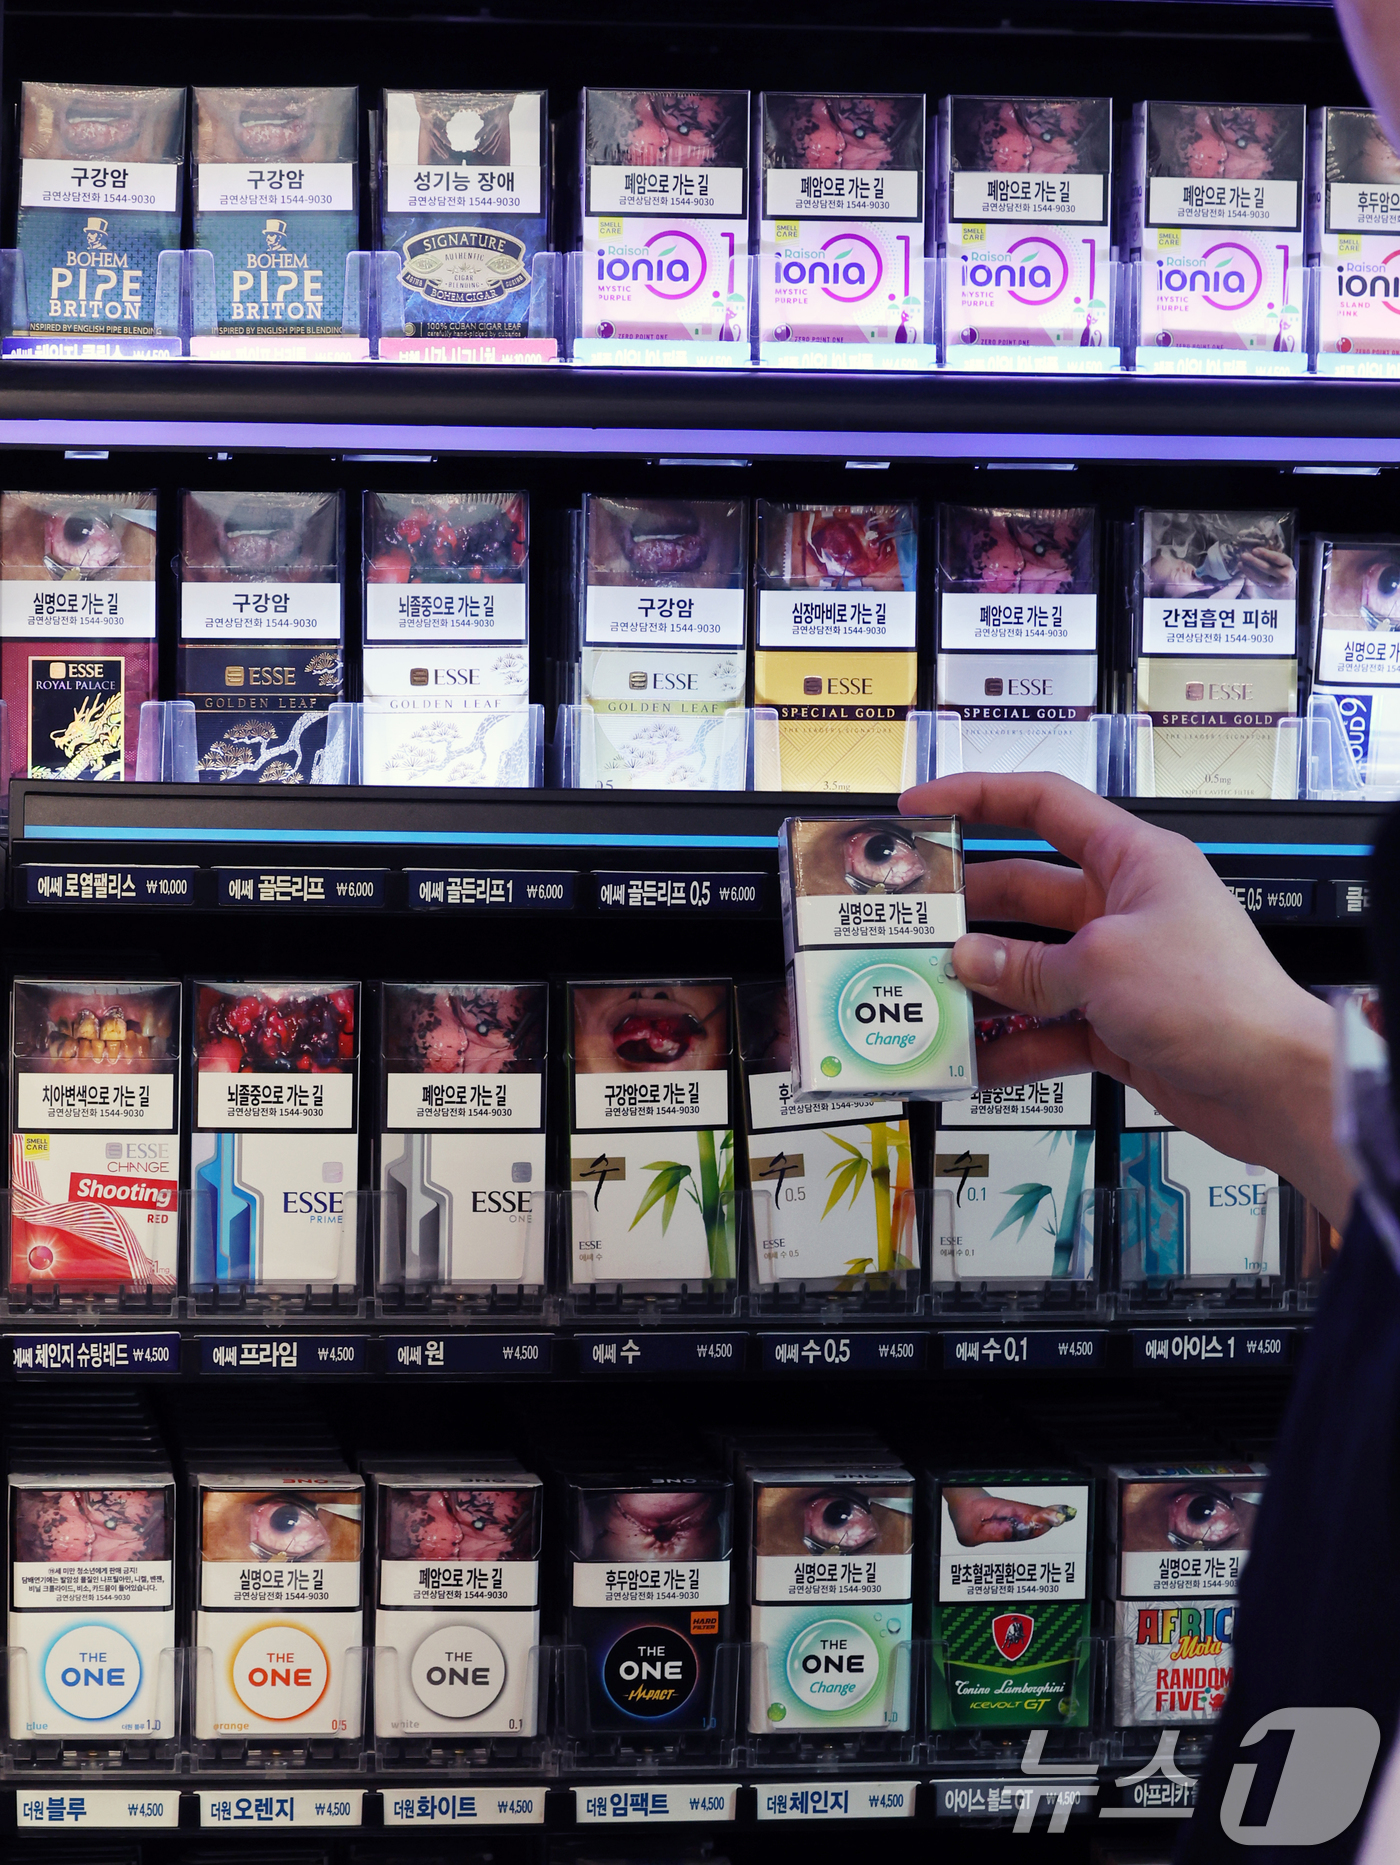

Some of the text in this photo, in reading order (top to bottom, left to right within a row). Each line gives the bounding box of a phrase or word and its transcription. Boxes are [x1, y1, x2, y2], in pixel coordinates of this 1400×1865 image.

[71, 168, 128, 188] 구강암
[414, 172, 514, 192] 성기능 장애
[625, 173, 709, 196] 폐암으로 가는 길
[42, 191, 156, 204] 금연상담전화 1544-9030
[982, 203, 1030, 212] 금연상담전화
[423, 234, 506, 252] SIGNATURE
[609, 246, 649, 255] Raison
[66, 251, 128, 267] BOHEM
[598, 249, 689, 282] ionia
[51, 268, 142, 301] PIPE
[431, 289, 498, 301] BOHEM CIGAR
[49, 300, 141, 319] BRITON
[34, 593, 118, 615] 실명으로 가는 길
[233, 593, 290, 613] 구강암
[399, 596, 494, 617] 뇌졸중으로 가는 길
[792, 603, 886, 624] 심장마비로 가는 길
[1163, 609, 1278, 629] 간접흡연 피해
[205, 618, 317, 628] 금연상담전화 1544-9030
[69, 664, 104, 677] ESSE
[248, 667, 296, 685] ESSE
[36, 681, 115, 690] ROYAL PALACE
[828, 678, 873, 694] ESSE
[205, 698, 317, 708] GOLDEN LEAF
[782, 708, 895, 718] SPECIAL GOLD
[1205, 774, 1231, 784] 0.5mg
[146, 880, 187, 895] ₩10,000
[336, 882, 373, 897] ₩6,000
[527, 884, 563, 899] ₩6,000
[719, 886, 755, 901] ₩6,000
[1268, 893, 1302, 907] ₩5,000
[839, 901, 928, 925] 실명으로 가는 길
[873, 986, 903, 996] THE
[855, 1003, 923, 1023] ONE
[866, 1032, 916, 1048] Change
[43, 1085, 149, 1107] 치아변색으로 가는 길
[127, 1143, 169, 1158] ESSE
[107, 1162, 169, 1172] CHANGE
[77, 1179, 171, 1207] Shooting
[785, 1187, 806, 1202] 0.5
[1208, 1184, 1267, 1207] ESSE
[283, 1192, 344, 1213] ESSE
[147, 1215, 168, 1223] RED
[318, 1347, 354, 1361] ₩4,500
[503, 1346, 539, 1360] ₩4,500
[697, 1344, 733, 1358] ₩4,500
[879, 1343, 913, 1358] ₩4,500
[1059, 1342, 1093, 1356] ₩4,500
[1247, 1339, 1281, 1354] ₩4,500
[35, 1344, 74, 1368] 체인지
[77, 1343, 129, 1368] 슈팅레드
[132, 1347, 169, 1362] ₩4,500
[605, 1569, 699, 1591] 후두암으로 가는 길
[951, 1562, 1075, 1585] 말초혈관질환으로 가는 길
[638, 1646, 665, 1656] THE
[1170, 1636, 1222, 1661] Mola
[79, 1653, 107, 1662] THE
[61, 1668, 125, 1686] ONE
[619, 1661, 682, 1680] ONE
[955, 1680, 1065, 1696] Tonino Lamborghini
[1024, 1699, 1051, 1713] GT
[1156, 1691, 1205, 1712] FIVE
[498, 1800, 533, 1814] ₩4,500
[689, 1797, 724, 1811] ₩4,500
[869, 1794, 903, 1808] ₩4,500
[128, 1803, 163, 1816] ₩4,500
[315, 1802, 350, 1816] ₩4,500
